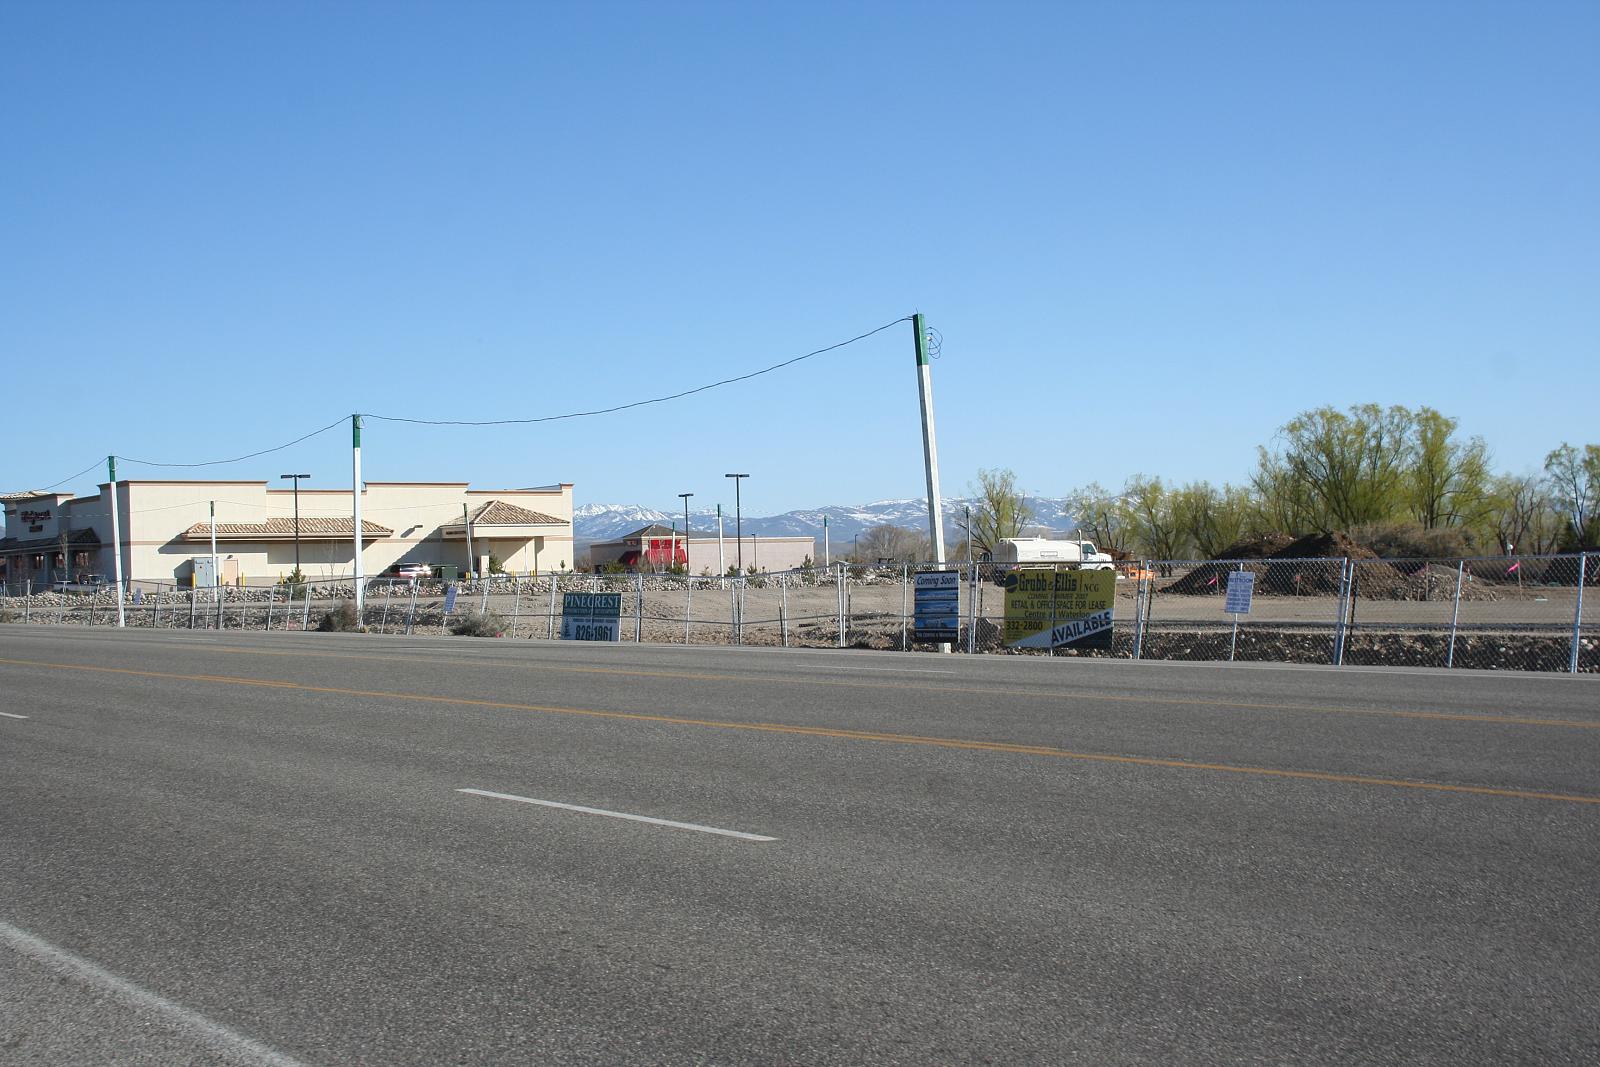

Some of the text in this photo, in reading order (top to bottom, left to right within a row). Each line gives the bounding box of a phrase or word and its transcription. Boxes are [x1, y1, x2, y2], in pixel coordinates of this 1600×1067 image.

[916, 575, 956, 587] Coming Soon
[1020, 573, 1047, 591] Grubb
[1056, 573, 1077, 591] Ellis
[1083, 583, 1099, 592] NCG
[565, 595, 620, 608] PINECREST
[1011, 600, 1029, 609] RETAIL
[1036, 600, 1054, 609] OFFICE
[1056, 600, 1073, 609] SPACE
[1075, 600, 1087, 609] FOR
[1089, 600, 1106, 609] LEASE
[1024, 610, 1046, 618] Centre
[1058, 609, 1091, 618] Waterloo
[1006, 621, 1043, 630] 332-2800
[1051, 611, 1111, 644] AVAILABLE
[575, 625, 613, 641] 826-1961
